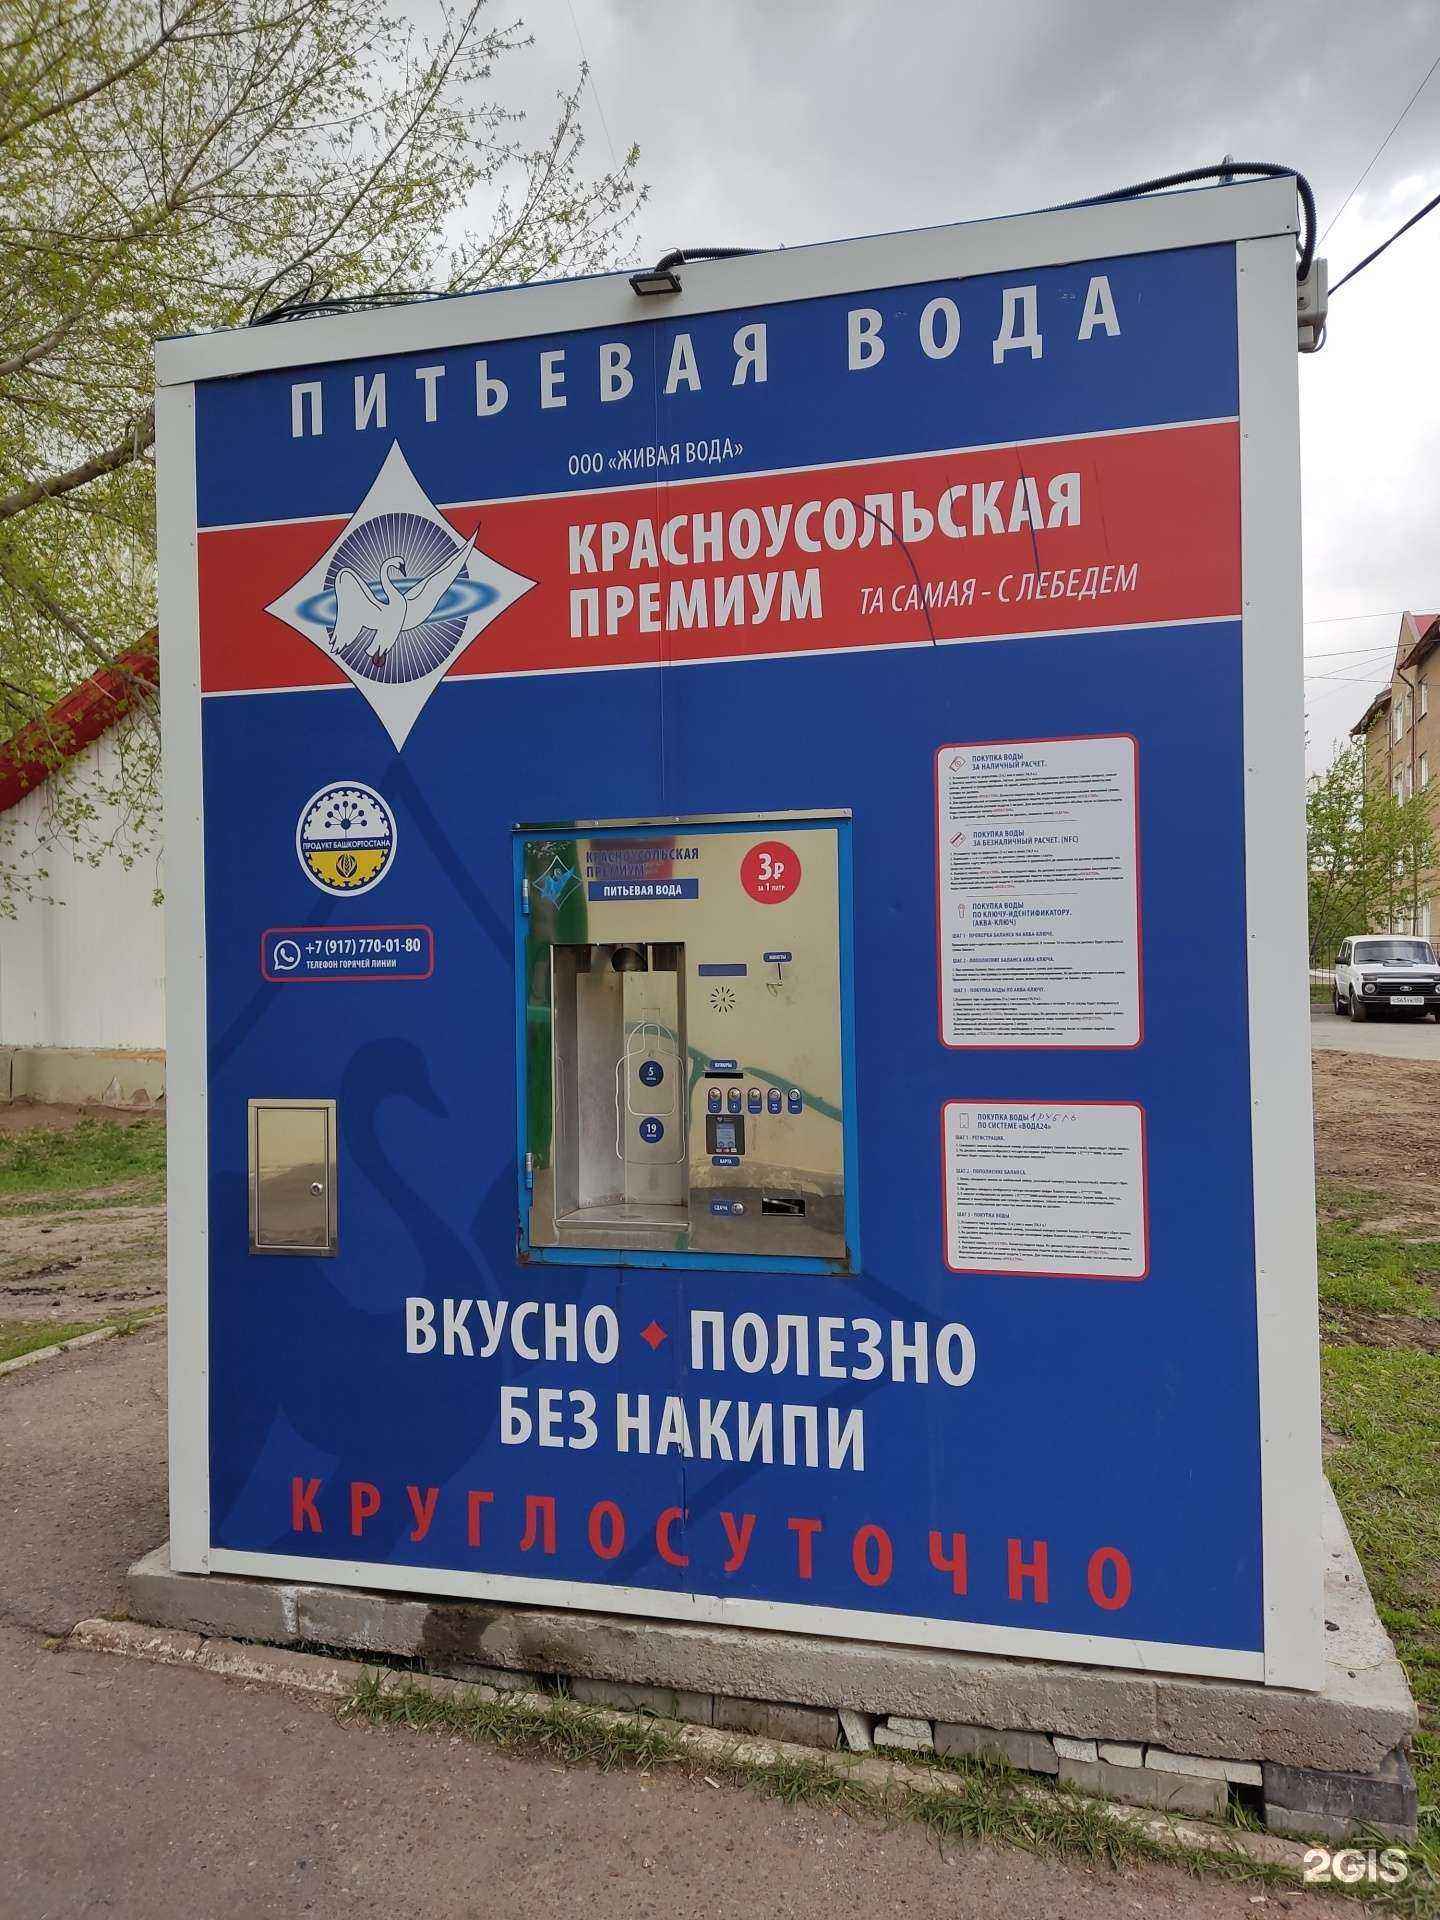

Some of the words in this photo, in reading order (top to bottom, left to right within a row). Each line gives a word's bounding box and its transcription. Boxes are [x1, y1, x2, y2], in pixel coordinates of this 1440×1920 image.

[290, 322, 769, 438] ПИТЬЕВАЯ
[847, 275, 1122, 373] ВОДА
[567, 452, 604, 476] ООО
[608, 442, 681, 472] «ЖИВАЯ
[685, 438, 744, 463] ВОДА»
[568, 472, 1081, 575] КРАСНОУСОЛЬСКАЯ
[859, 587, 885, 616] ТА
[891, 578, 975, 613] САМАЯ
[998, 573, 1013, 602] С
[1015, 562, 1139, 602] ЛЕБЕДЕМ
[569, 567, 823, 638] ПРЕМИУМ
[972, 755, 1003, 763] ПОКУПКА
[1004, 753, 1024, 761] ВОДЫ
[981, 761, 1020, 770] НАЛИЧНЫЙ
[1004, 829, 1024, 837] ВОДЫ
[302, 841, 333, 851] ПРОДУКТ
[333, 839, 391, 849] БАШКОРТОСТАНА
[973, 839, 981, 847] ЗА
[982, 837, 1033, 847] БЕЗНАЛИЧНЫЙ
[1061, 836, 1079, 844] (NFC)
[603, 886, 653, 897] ПИТЬЕВАЯ
[655, 884, 682, 896] ВОДА
[972, 902, 1003, 910] ПОКУПКА
[305, 940, 322, 954] +7
[325, 939, 356, 956] (917)
[359, 937, 421, 953] 770-01-80
[306, 960, 338, 969] ТЕЛЕФОН
[339, 959, 371, 969] ГОРЯЧЕЙ
[372, 959, 397, 968] ЛИНИИ
[648, 1067, 654, 1076] 5
[977, 1113, 1008, 1121] ПОКУПКА
[1009, 1114, 1029, 1122] ВОДЫ
[646, 1123, 657, 1135] 19
[977, 1121, 987, 1129] ПО
[988, 1122, 1018, 1130] СИСТЕМЕ
[405, 1296, 620, 1364] ВКУСНО
[691, 1310, 976, 1386] ПОЛЕЗНО
[500, 1386, 598, 1451] БЕЗ
[617, 1392, 865, 1472] НАКИПИ
[291, 1476, 1133, 1611] КРУГЛОСУТОЧНО
